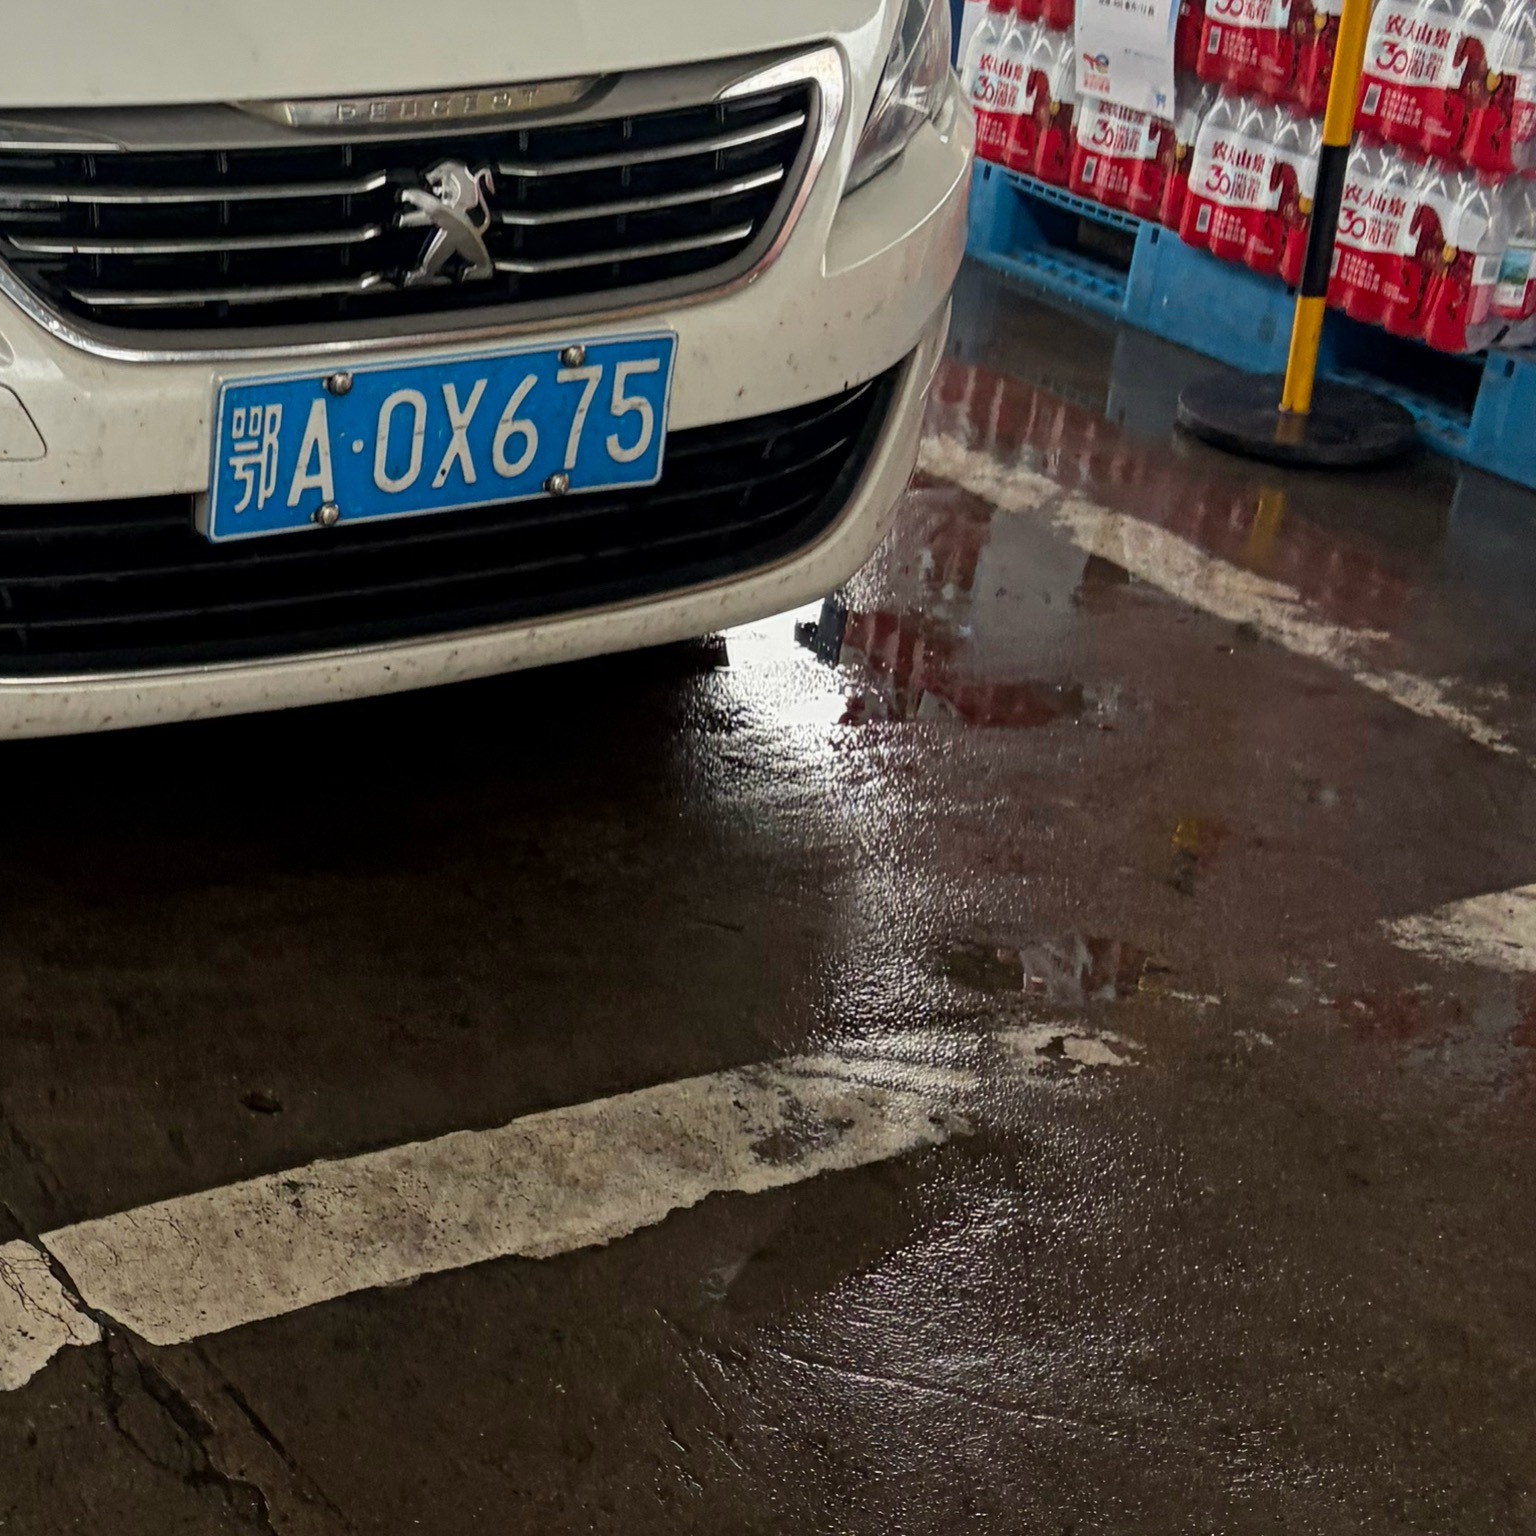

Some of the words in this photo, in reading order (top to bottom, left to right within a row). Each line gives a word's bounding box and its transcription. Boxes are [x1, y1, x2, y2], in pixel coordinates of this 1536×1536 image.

[1385, 14, 1452, 51] 农夫山泉
[1343, 183, 1407, 219] 农夫山泉
